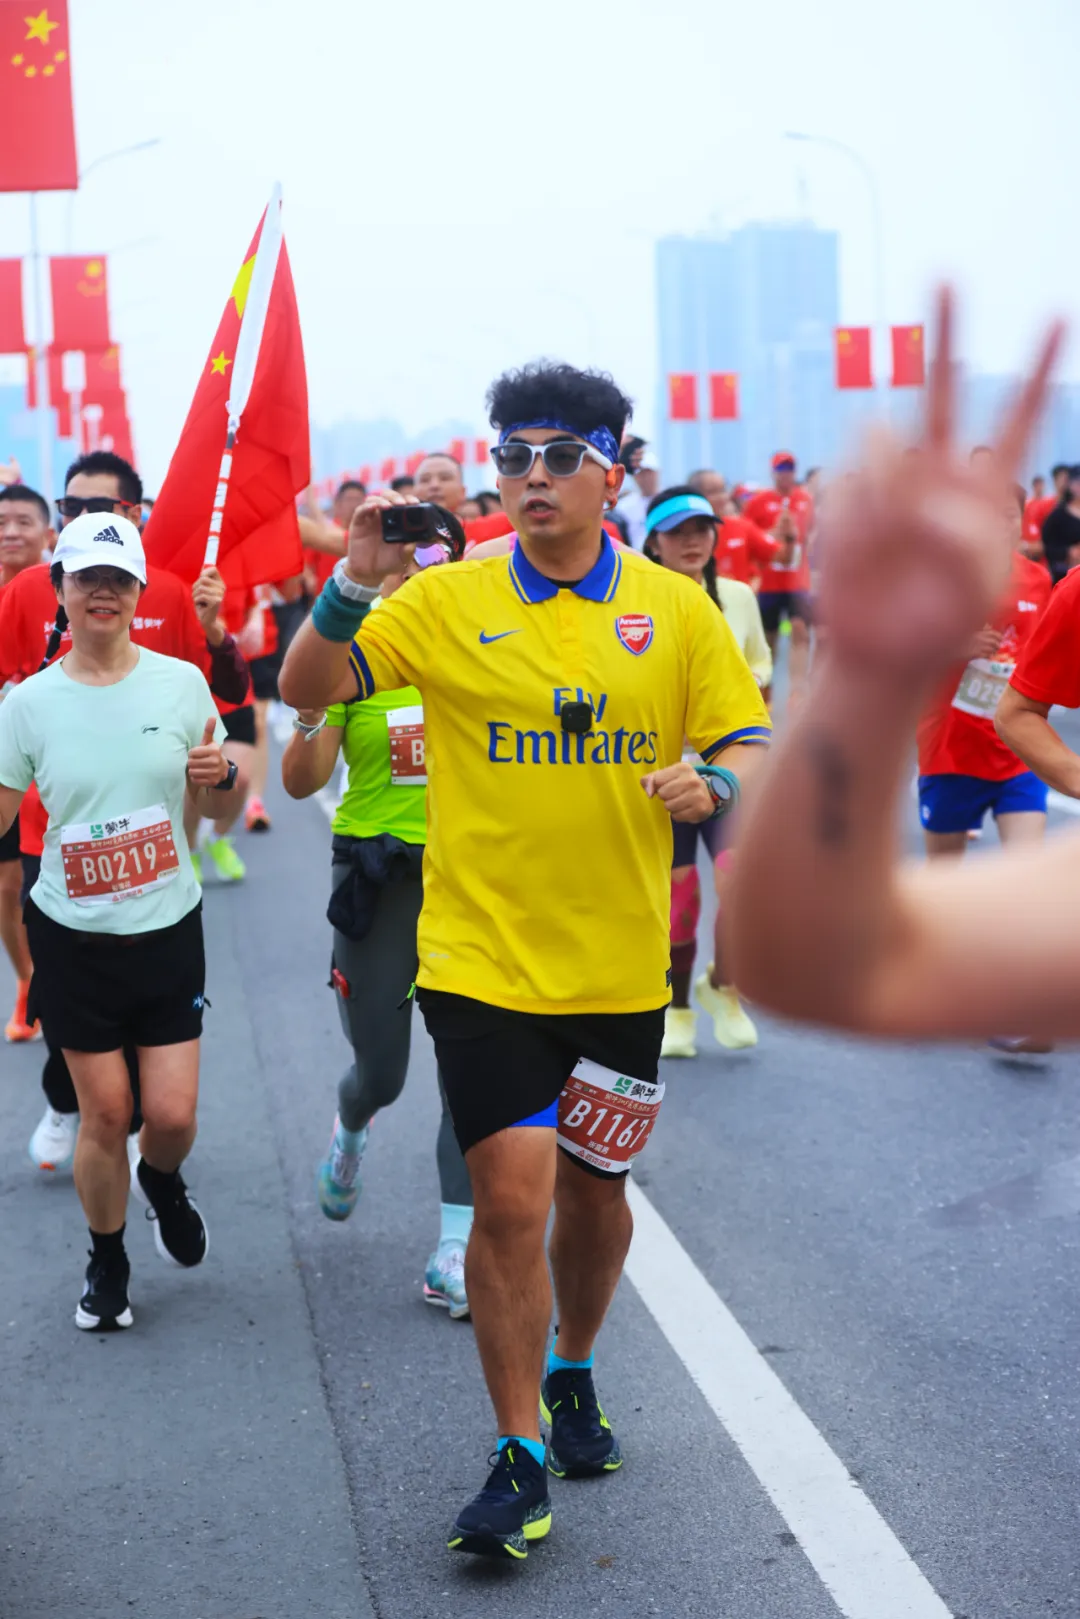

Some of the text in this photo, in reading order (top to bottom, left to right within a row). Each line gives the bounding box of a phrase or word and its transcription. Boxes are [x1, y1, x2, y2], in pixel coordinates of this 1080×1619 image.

[93, 535, 124, 546] adidas
[552, 687, 608, 723] Fly
[486, 721, 658, 765] Emirates
[104, 818, 131, 836] 蒙牛
[81, 842, 157, 885] B0219
[630, 1082, 658, 1102] 蒙牛
[563, 1099, 650, 1149] B1167
